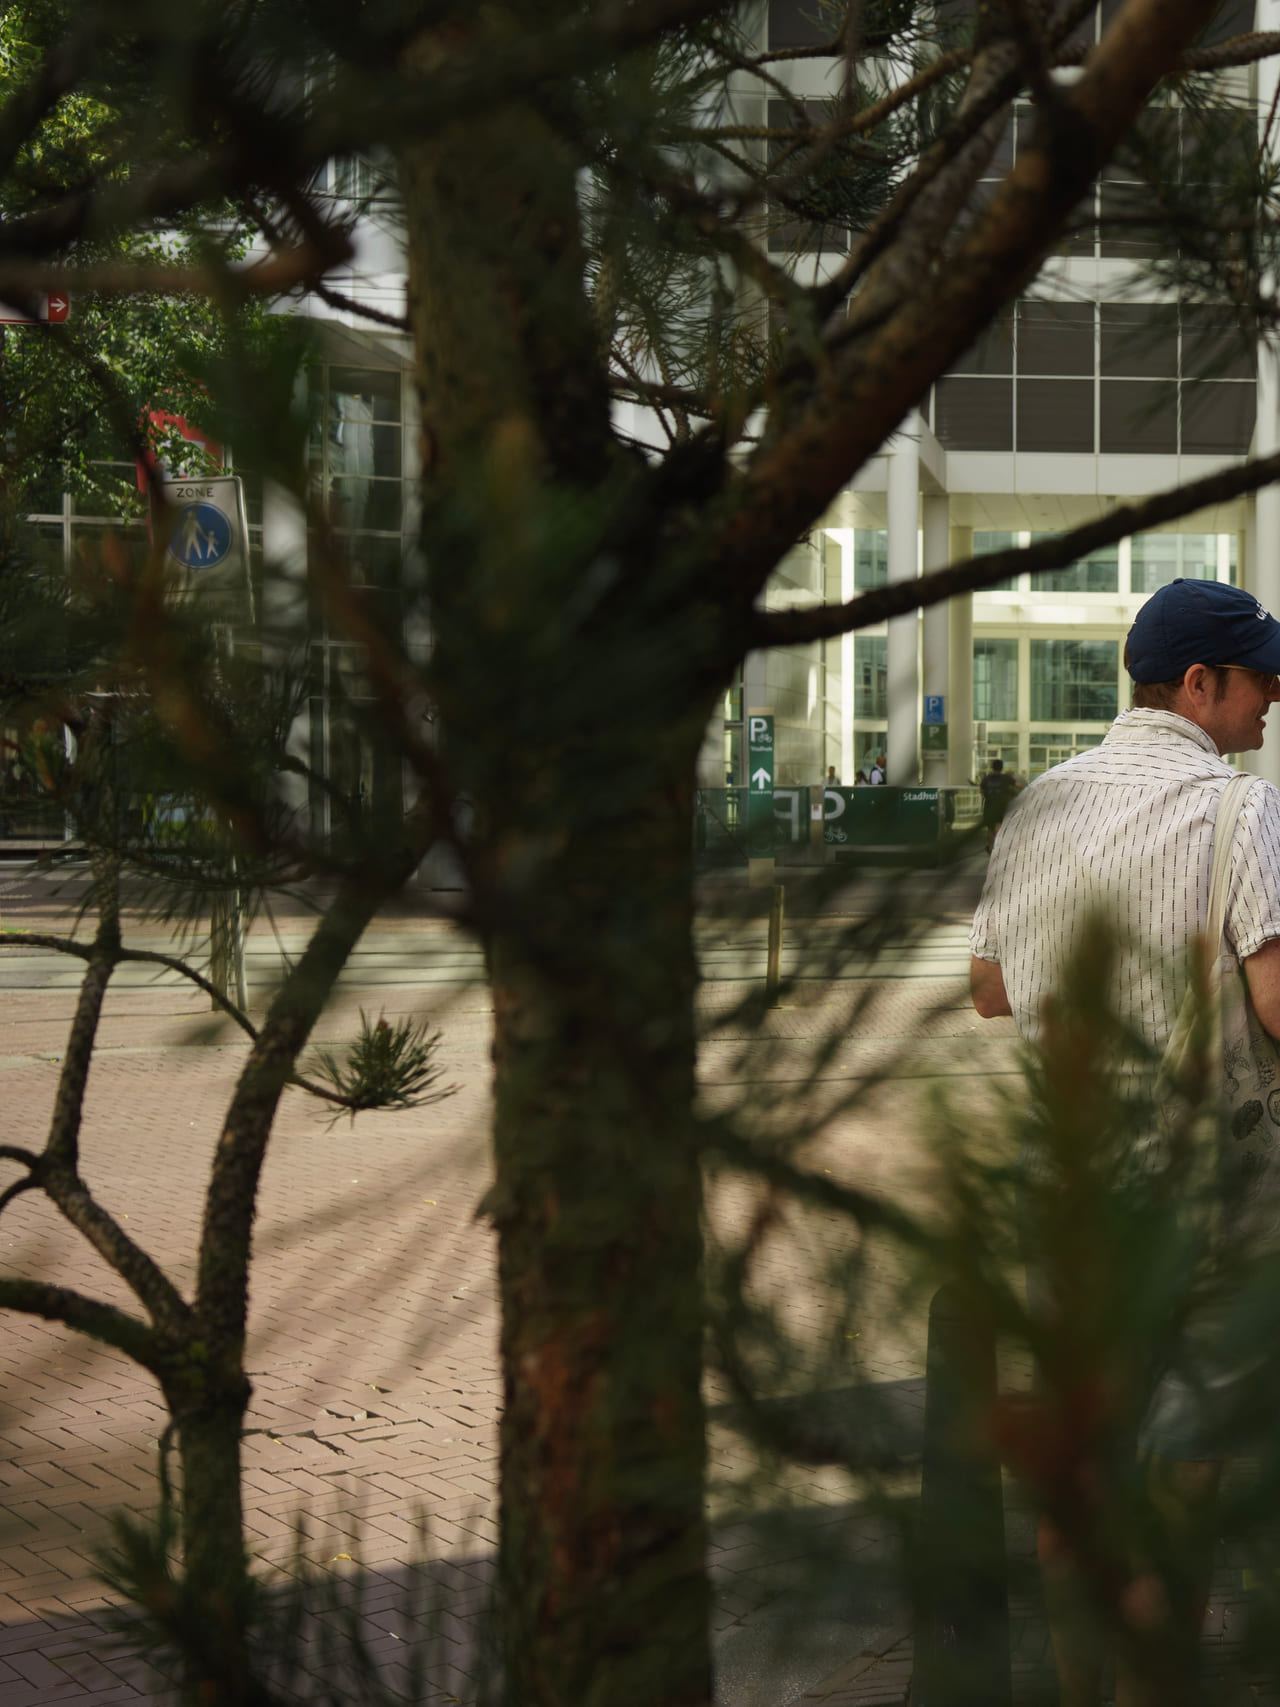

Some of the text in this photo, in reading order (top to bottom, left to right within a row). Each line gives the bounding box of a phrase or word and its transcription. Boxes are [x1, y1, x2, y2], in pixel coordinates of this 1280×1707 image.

[176, 488, 214, 498] ZONE
[929, 697, 940, 711] P
[750, 717, 768, 743] P
[903, 791, 938, 801] Stadhui
